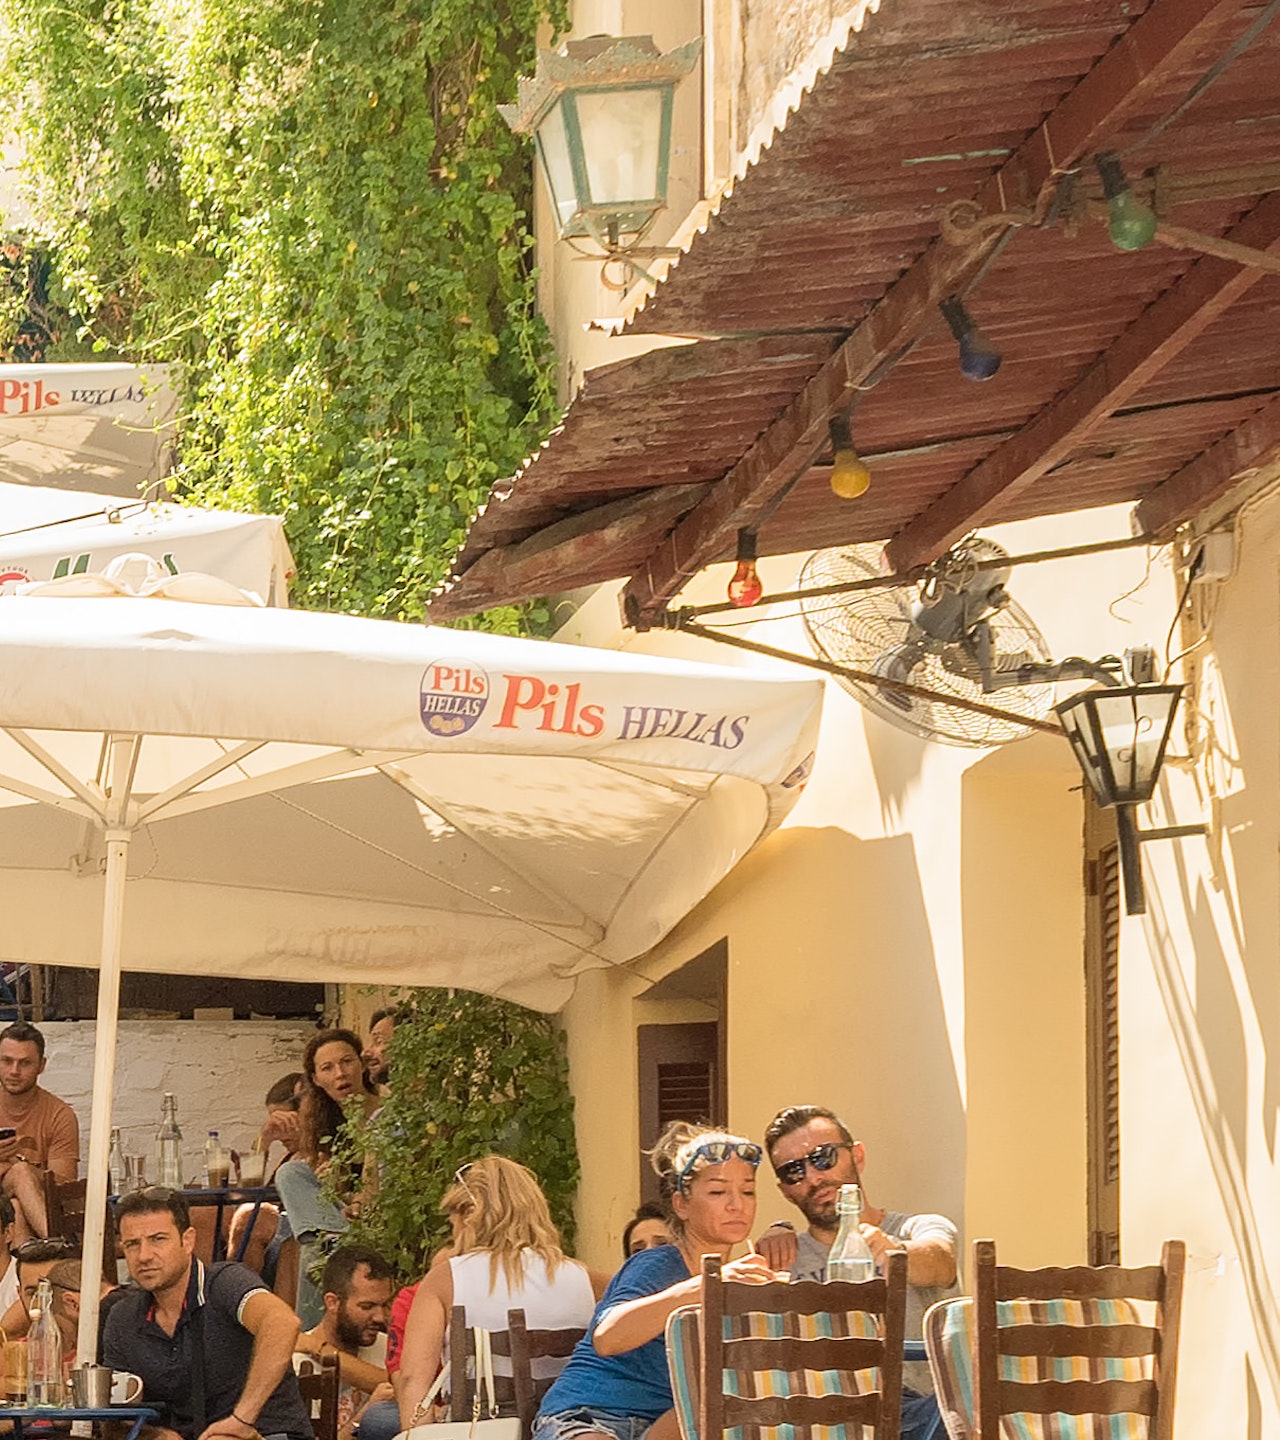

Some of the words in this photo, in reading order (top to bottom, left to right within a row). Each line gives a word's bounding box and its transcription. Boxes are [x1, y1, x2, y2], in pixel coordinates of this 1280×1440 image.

[431, 664, 486, 695] Pils
[423, 693, 483, 717] HELLAS
[492, 673, 606, 738] Pils
[616, 705, 751, 751] HELLAS
